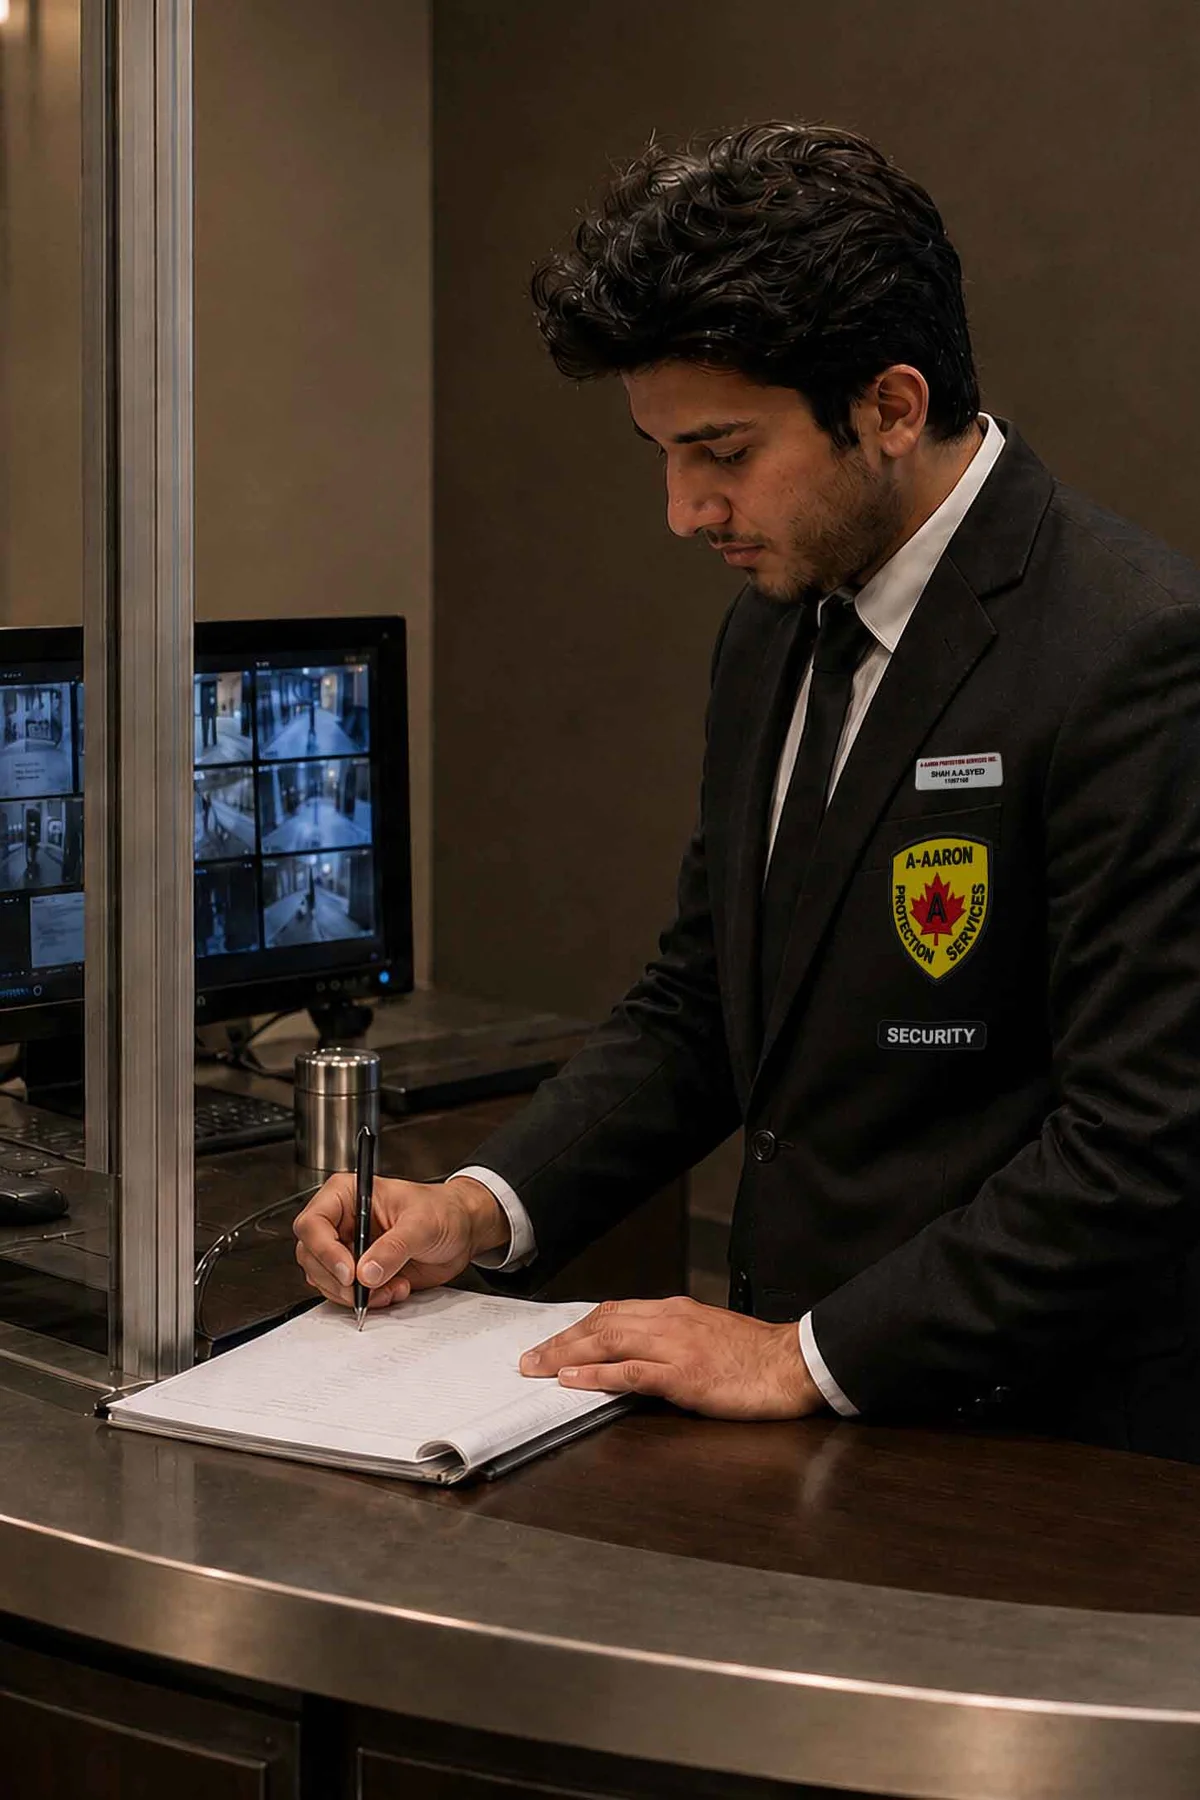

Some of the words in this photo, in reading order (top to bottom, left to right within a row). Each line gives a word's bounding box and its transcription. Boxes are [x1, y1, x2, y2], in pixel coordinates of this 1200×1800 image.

[939, 759, 965, 767] PROTECTION
[966, 757, 987, 765] SERVICES
[931, 770, 950, 778] SHAH
[905, 846, 974, 869] A-AARON
[927, 892, 948, 924] A
[895, 884, 935, 965] PROTECTION
[946, 883, 985, 962] SERVICES
[886, 1026, 976, 1045] SECURITY
